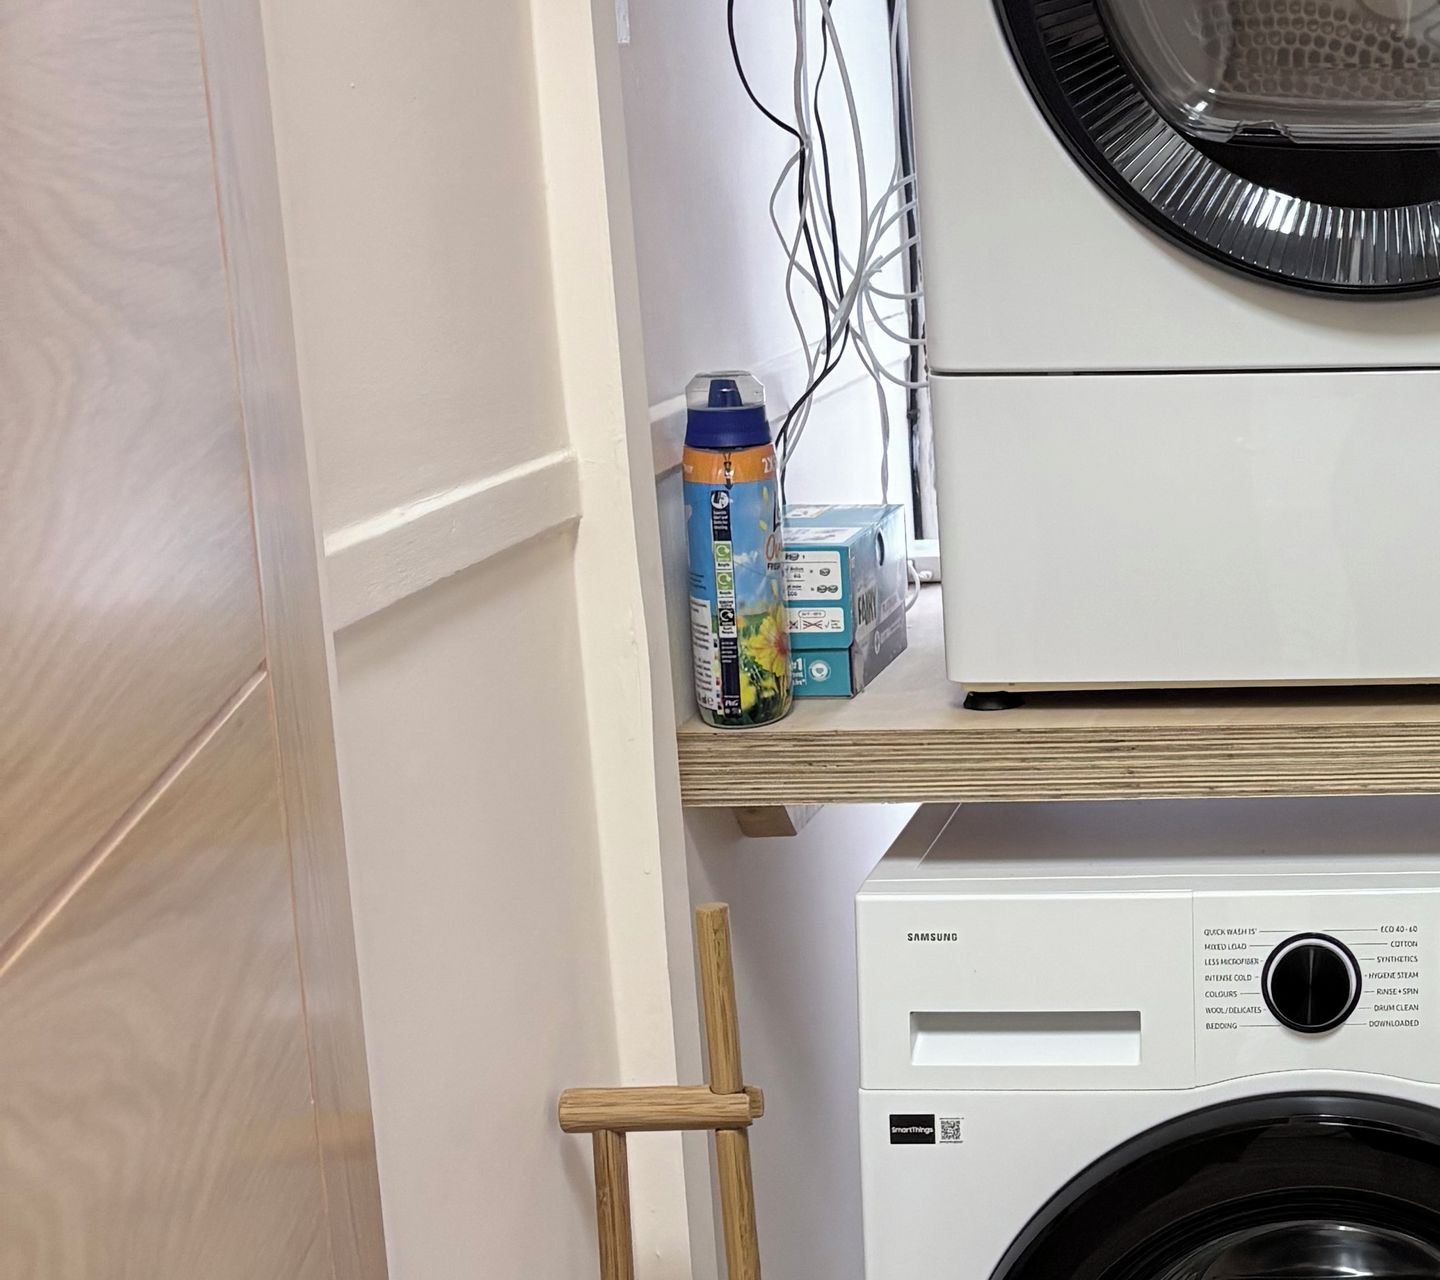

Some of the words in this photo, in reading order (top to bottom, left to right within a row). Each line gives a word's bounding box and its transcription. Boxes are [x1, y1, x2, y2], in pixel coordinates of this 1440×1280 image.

[1227, 928, 1246, 936] WASH
[907, 933, 958, 942] SAMSUNG
[1228, 942, 1247, 950] LOAD
[1390, 940, 1418, 948] COTTON
[1205, 958, 1220, 966] LESS
[1205, 974, 1233, 982] INTENSE
[1368, 972, 1396, 980] HYGIENE
[1205, 990, 1238, 998] COLOURS
[1374, 1004, 1394, 1012] DRUM
[1396, 1004, 1418, 1012] CLEAN
[1206, 1022, 1238, 1030] BEDDING
[1369, 1020, 1419, 1028] DOWNLOADED
[892, 1126, 934, 1134] SmartThings
